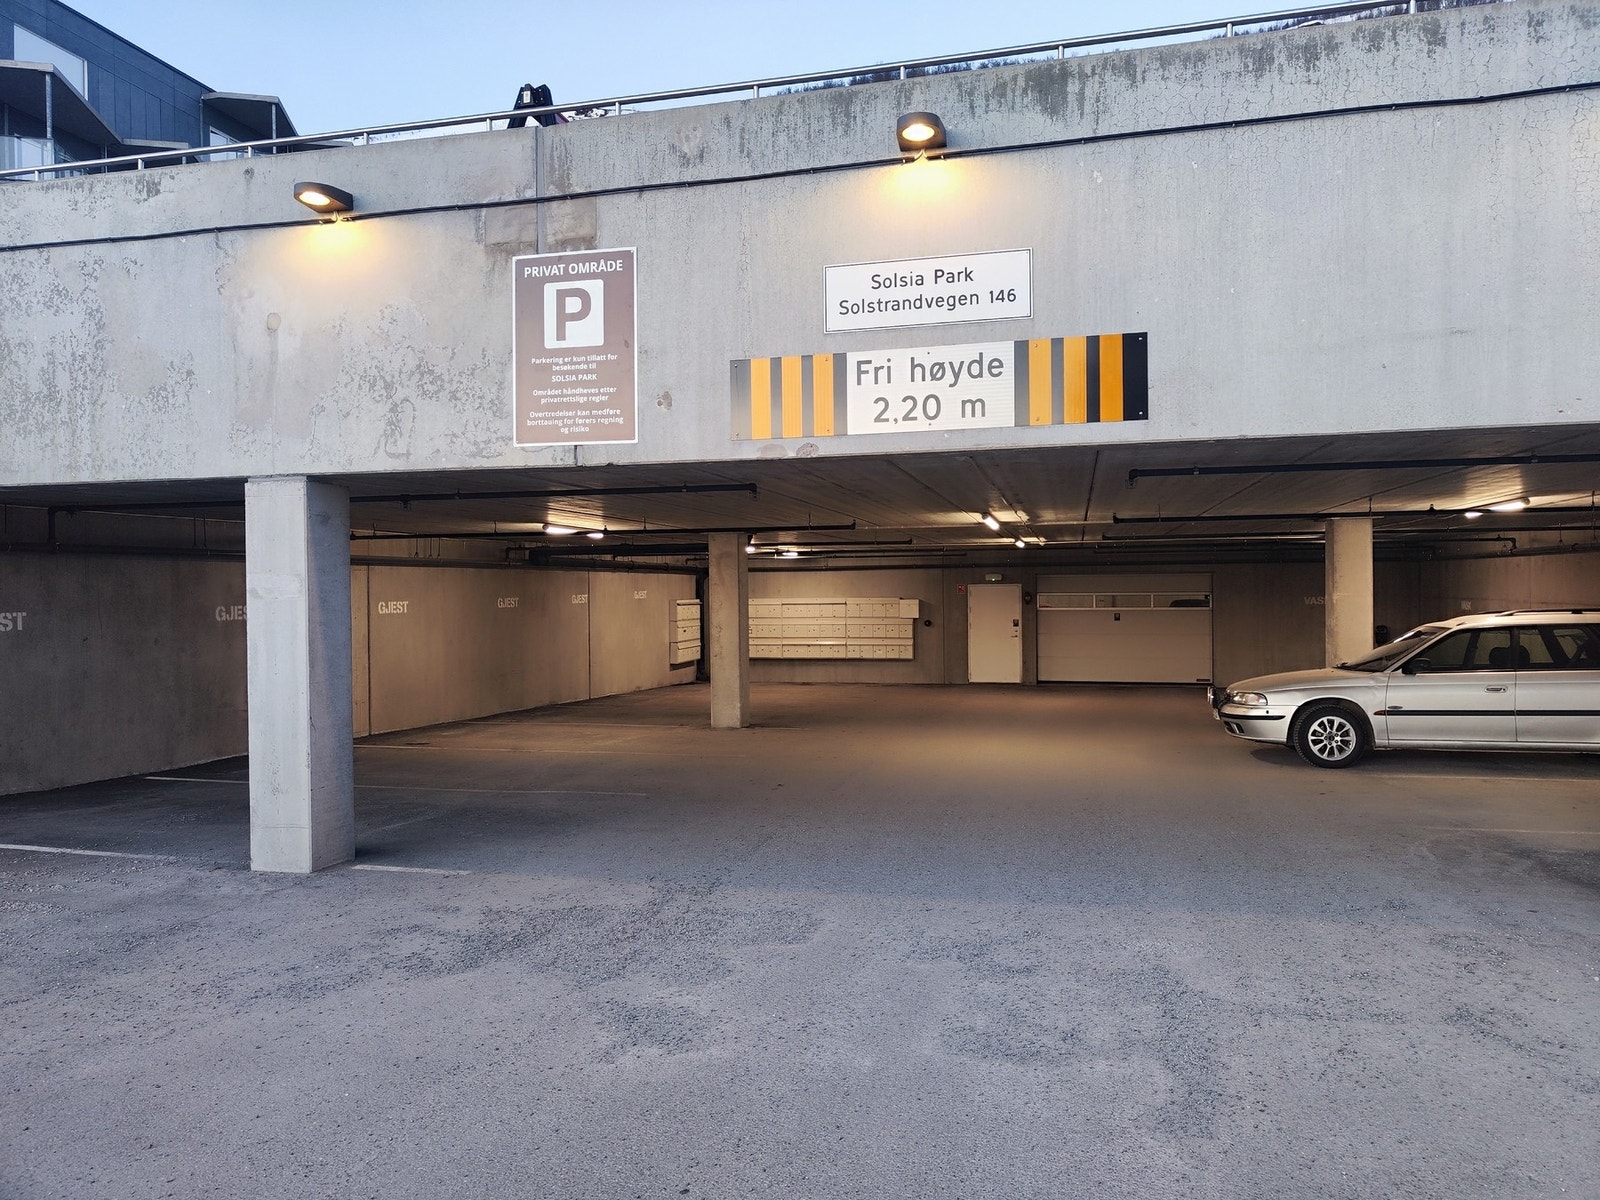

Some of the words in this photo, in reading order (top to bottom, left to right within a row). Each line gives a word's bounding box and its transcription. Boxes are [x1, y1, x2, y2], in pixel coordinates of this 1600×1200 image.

[524, 264, 566, 278] PRIVAT
[568, 258, 623, 275] OMRÅDE
[870, 271, 925, 290] Solsia
[934, 267, 974, 285] Park
[839, 294, 980, 316] Solstrandvegen
[989, 288, 1017, 304] 146
[555, 287, 592, 342] P
[531, 357, 564, 365] Parkering
[564, 355, 572, 363] er
[572, 354, 586, 362] kun
[587, 353, 607, 362] tillatt
[607, 353, 618, 361] for
[856, 358, 892, 386] Fri
[910, 351, 1004, 388] høyde
[551, 374, 577, 382] SOLSIA
[578, 373, 598, 381] PARK
[532, 388, 562, 396] Området
[562, 387, 599, 395] håndheves
[599, 386, 617, 394] etter
[540, 396, 588, 404] privatrettslige
[588, 394, 609, 403] regler
[529, 410, 576, 418] Overtredelser
[591, 408, 621, 416] medføre
[873, 393, 942, 424] 2,20
[961, 397, 986, 418] m
[597, 416, 624, 425] regning
[497, 597, 520, 608] GJEST
[571, 594, 588, 604] GJEST
[378, 601, 409, 614] GJEST
